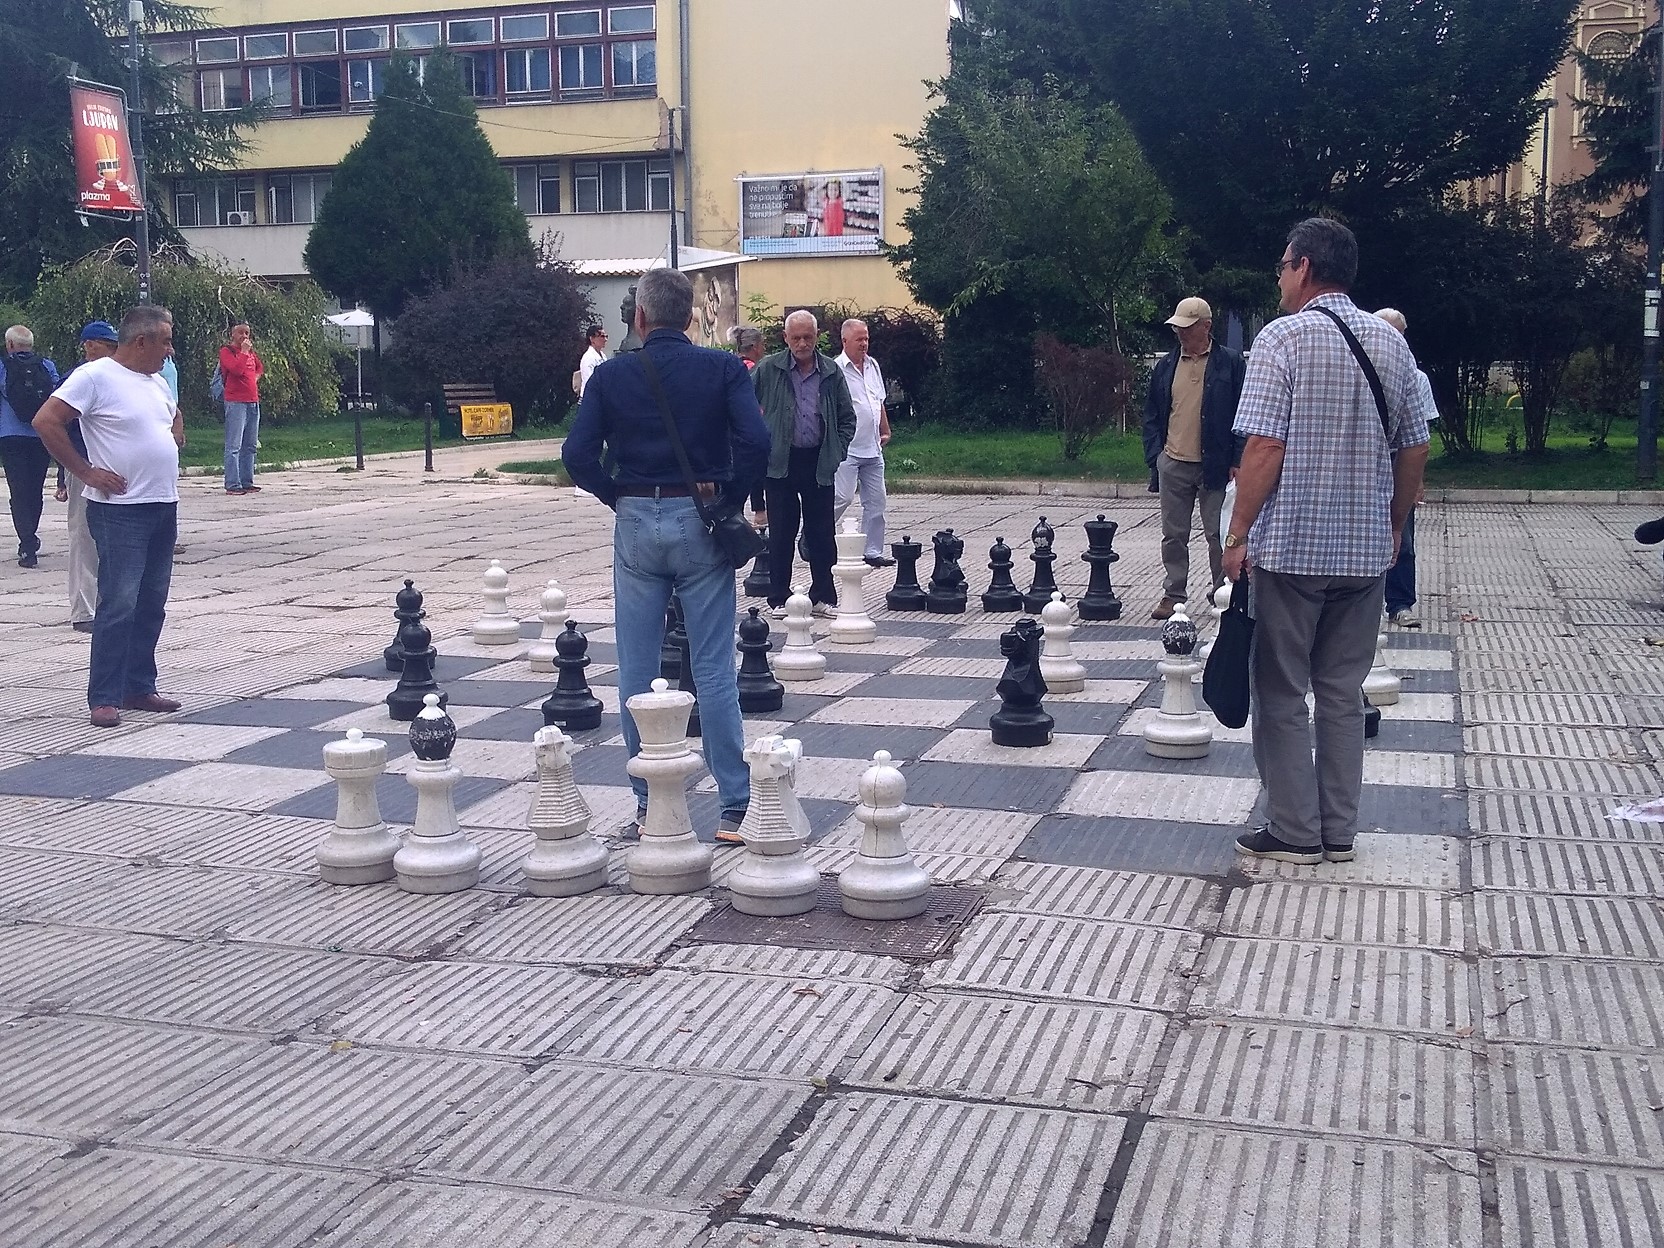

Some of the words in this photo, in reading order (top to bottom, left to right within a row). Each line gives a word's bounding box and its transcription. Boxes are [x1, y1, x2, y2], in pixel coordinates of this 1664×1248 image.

[748, 184, 770, 193] Važno
[788, 183, 798, 192] da
[81, 190, 110, 201] plazma
[749, 194, 758, 202] ne
